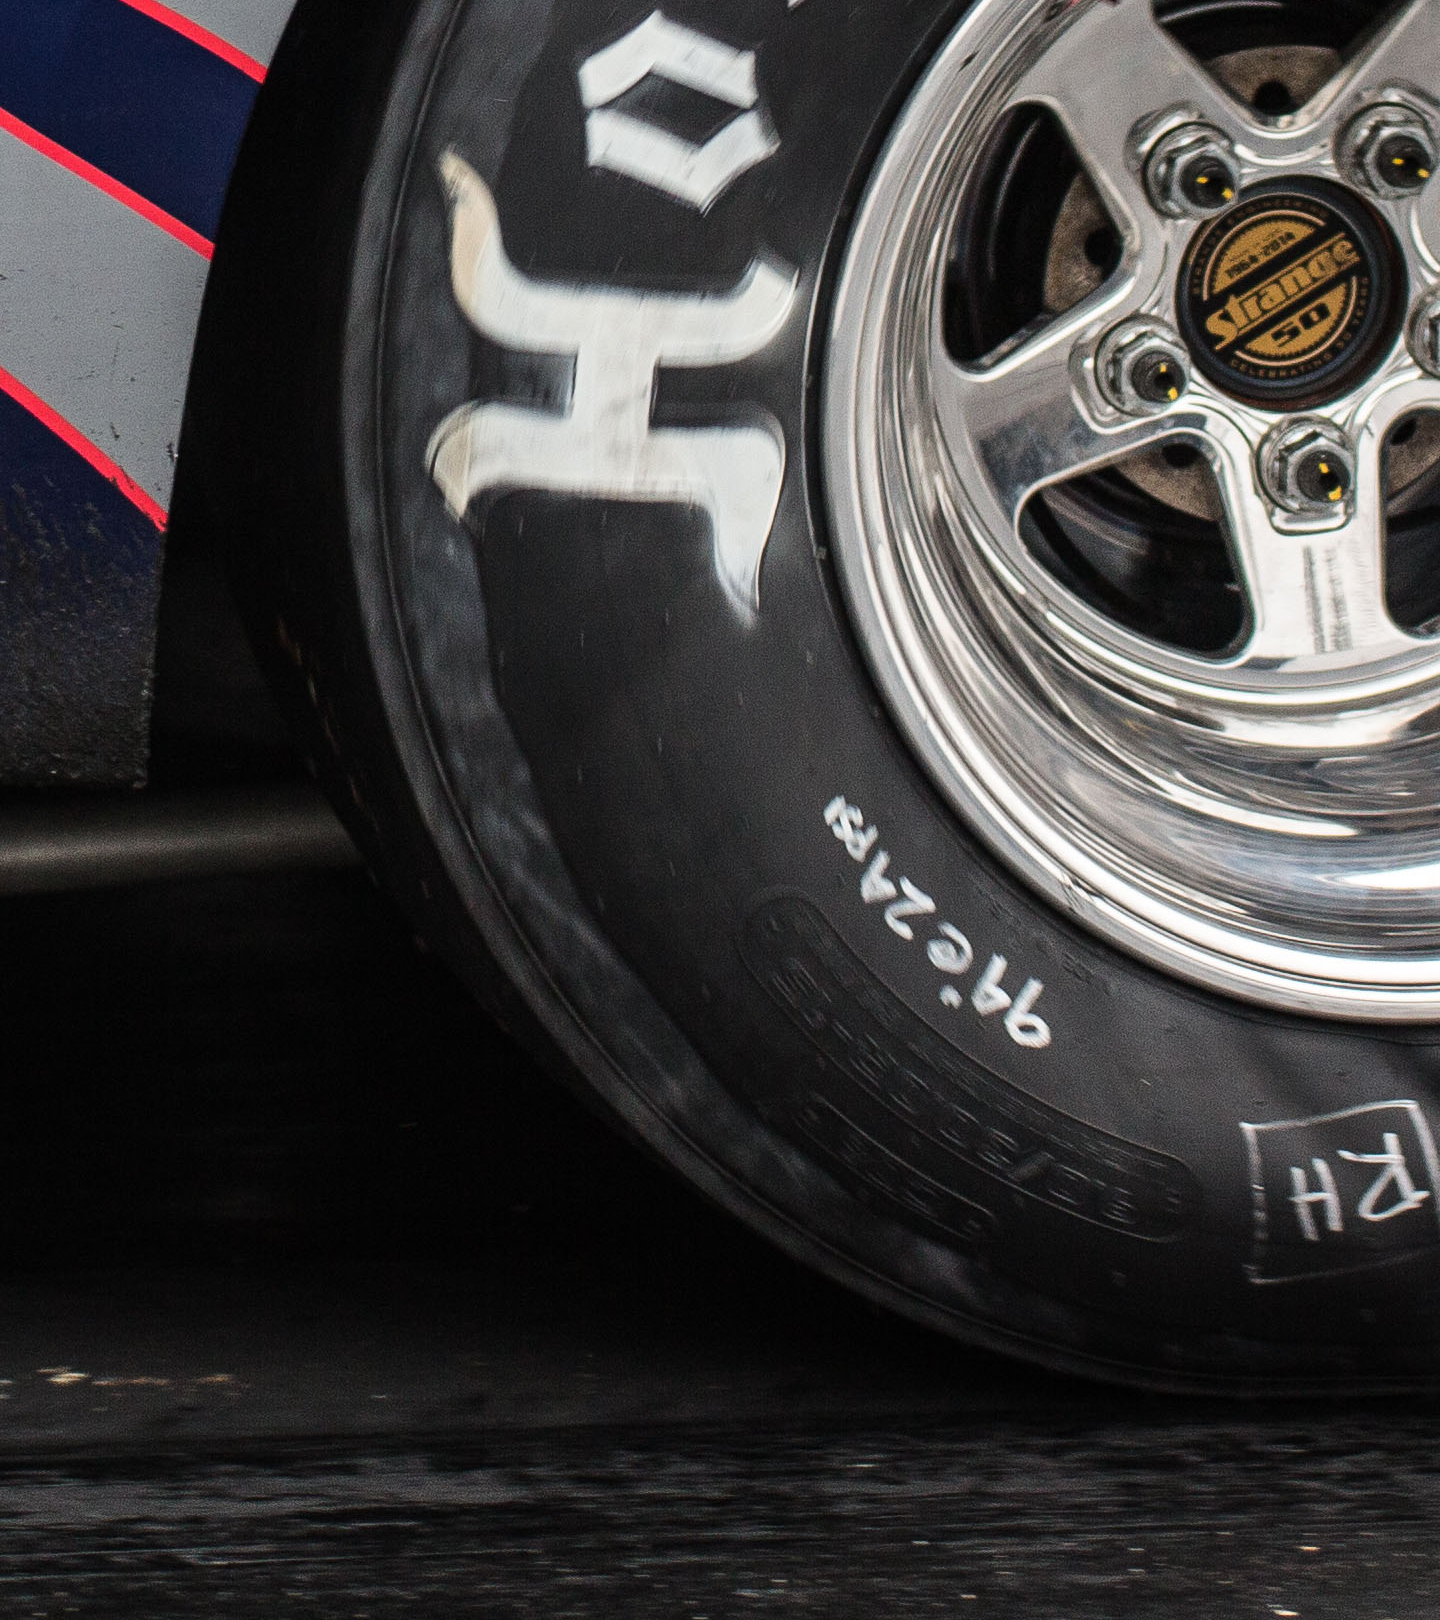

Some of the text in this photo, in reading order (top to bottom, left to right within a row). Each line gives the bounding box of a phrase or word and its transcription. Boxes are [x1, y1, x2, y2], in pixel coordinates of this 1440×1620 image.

[1206, 237, 1360, 352] Strange
[1271, 302, 1331, 348] 50
[1289, 1132, 1430, 1242] RH
